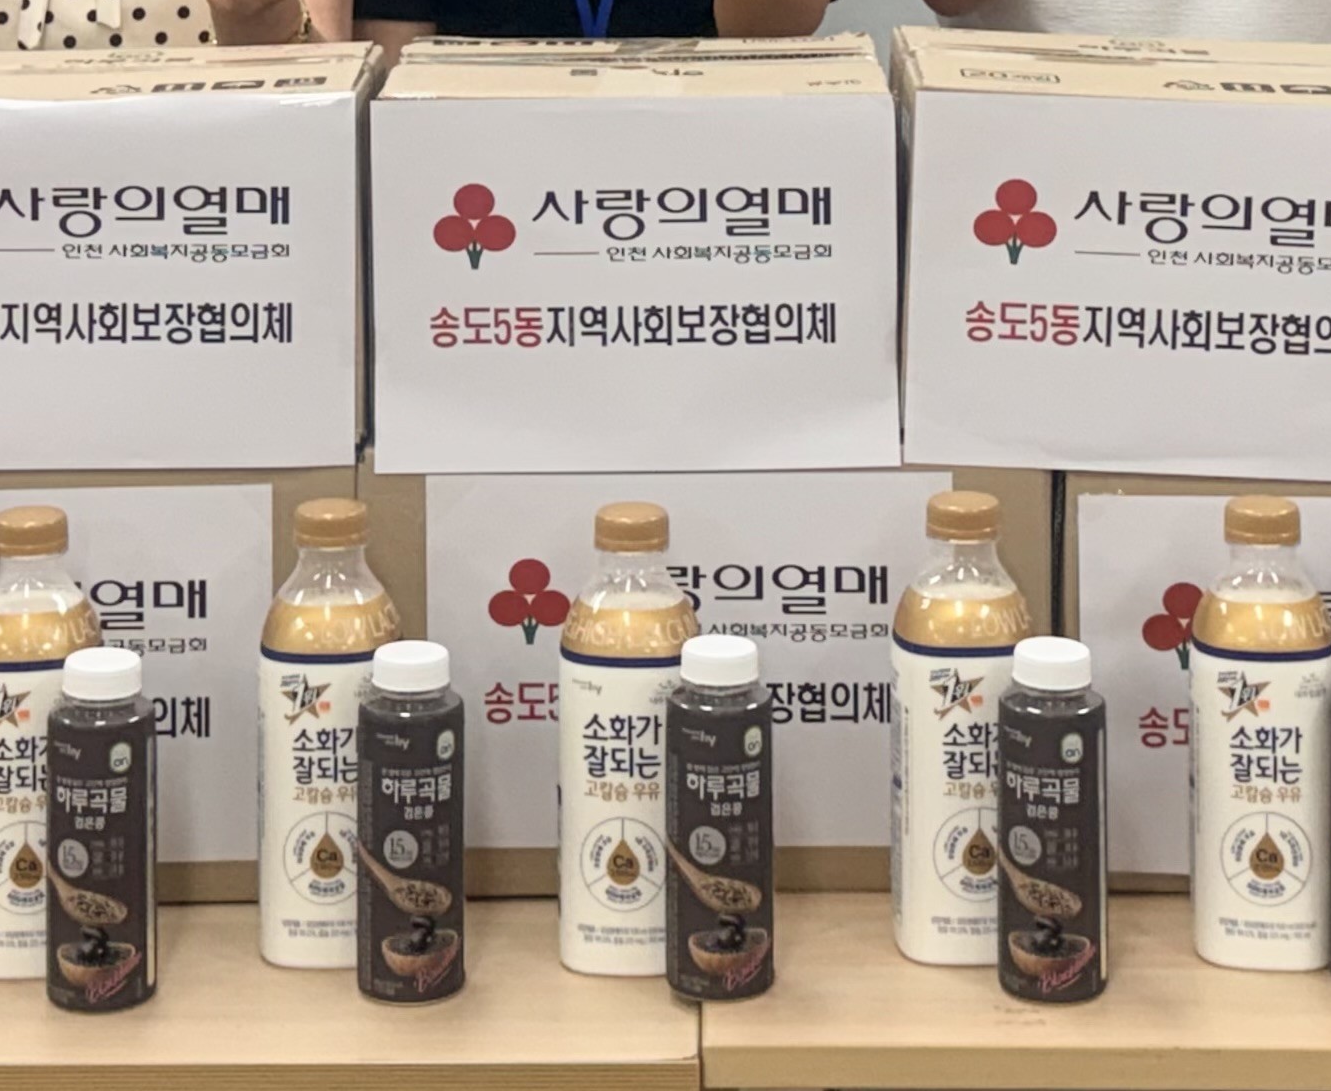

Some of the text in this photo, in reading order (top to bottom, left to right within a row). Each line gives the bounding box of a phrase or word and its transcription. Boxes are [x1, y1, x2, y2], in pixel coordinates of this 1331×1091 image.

[532, 186, 832, 240] 사랑의열매
[61, 242, 290, 264] 인천 사회복지공동모금회
[606, 244, 832, 265] 인천 사회복지공동모금회
[1147, 248, 1189, 266] 인천
[666, 564, 889, 614] 랑의열매
[582, 713, 662, 745] 소화가
[1229, 726, 1302, 754] 소화가
[583, 745, 661, 779] 잘되는
[1230, 754, 1302, 784] 잘되는
[55, 786, 127, 814] 하루곡물
[381, 773, 452, 805] 하루곡물
[584, 779, 660, 803] 고칼슘 우유
[686, 770, 761, 801] 하루곡물
[1006, 772, 1080, 805] 하루곡물
[1231, 784, 1302, 804] 고칼슘 우유
